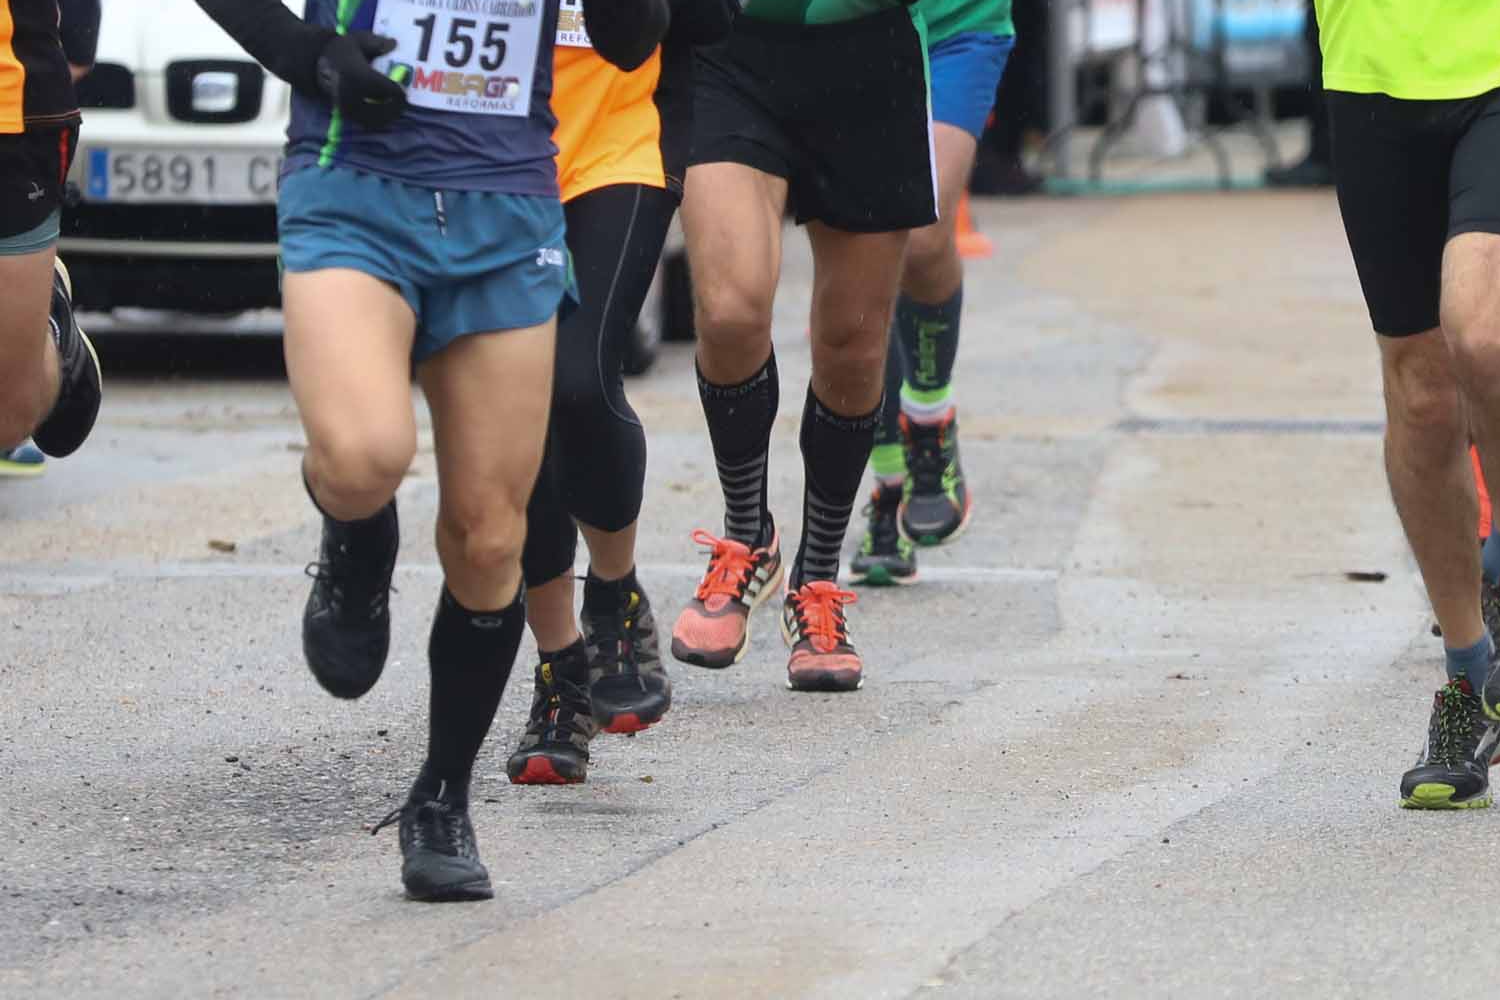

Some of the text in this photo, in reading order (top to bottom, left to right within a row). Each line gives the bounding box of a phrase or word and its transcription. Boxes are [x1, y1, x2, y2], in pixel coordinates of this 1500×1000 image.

[413, 13, 511, 72] 155
[446, 97, 516, 111] REFORMAS
[112, 155, 216, 195] 5891
